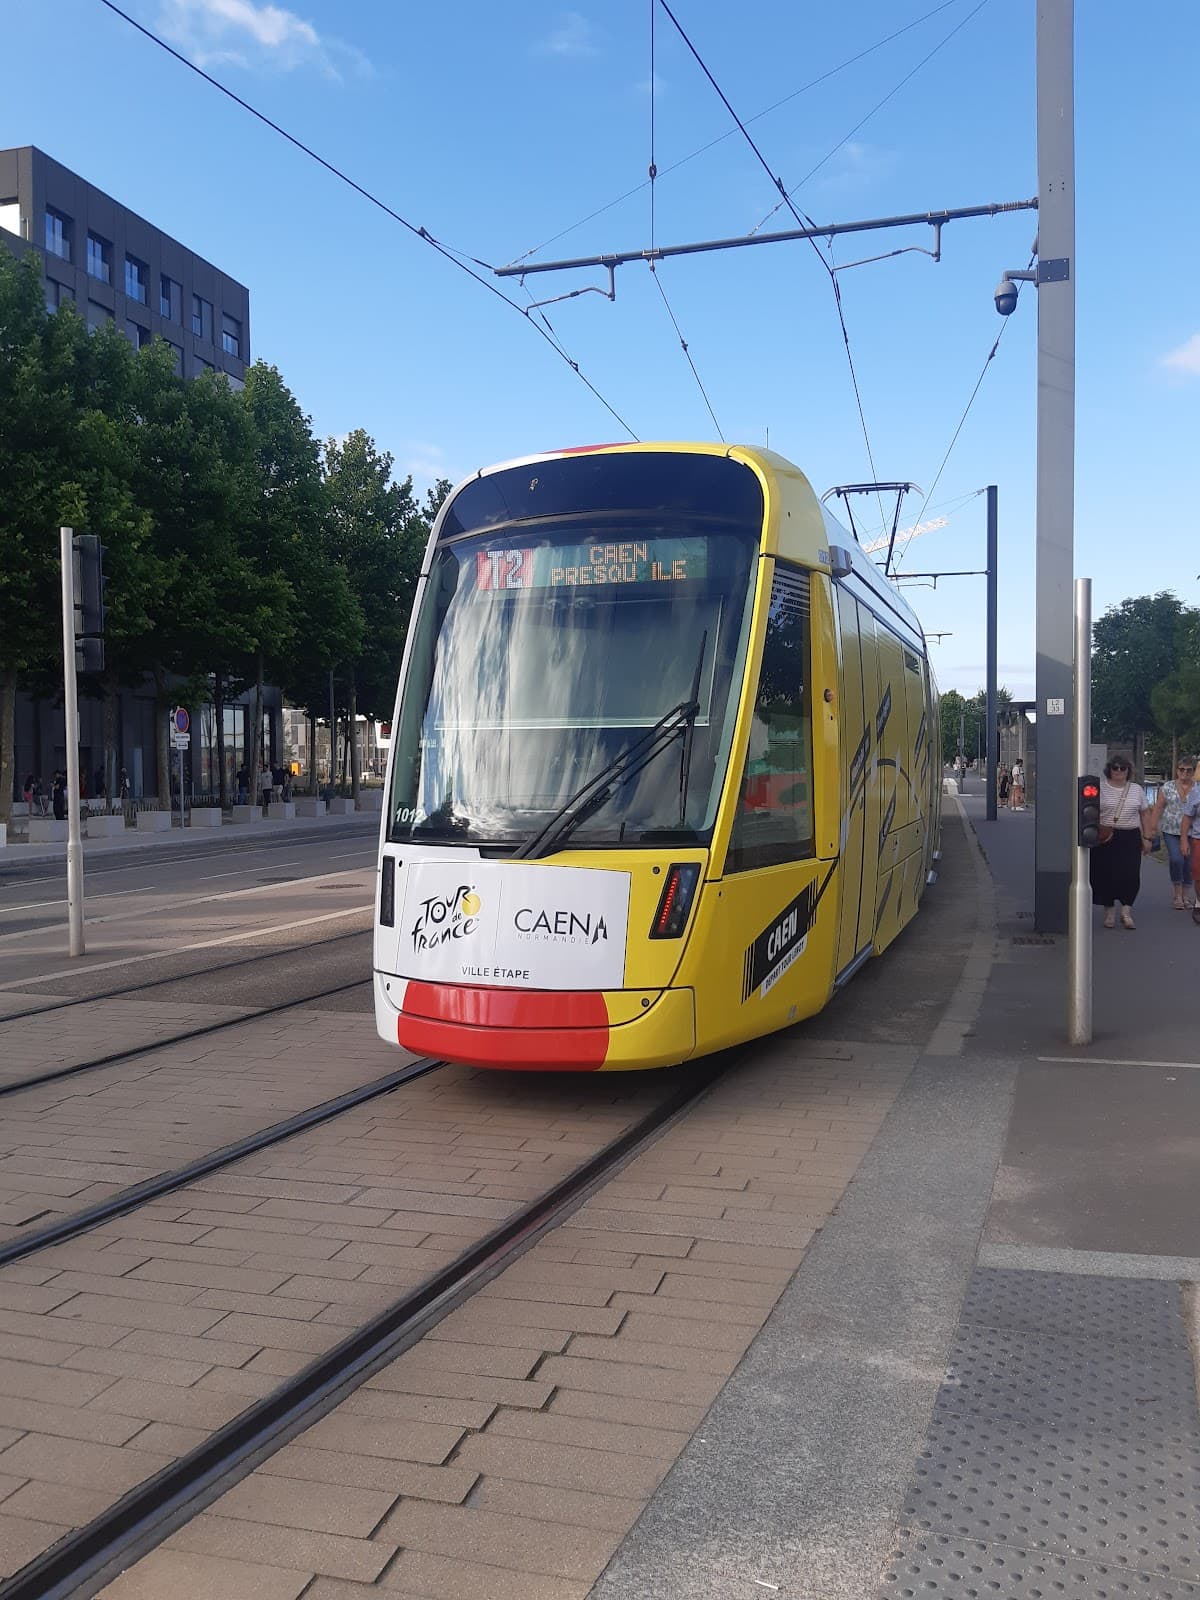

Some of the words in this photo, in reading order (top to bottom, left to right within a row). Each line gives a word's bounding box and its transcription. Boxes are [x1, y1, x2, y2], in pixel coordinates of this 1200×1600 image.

[588, 543, 648, 565] CAEN
[487, 549, 523, 589] T2
[551, 564, 637, 587] PRESQU
[650, 560, 687, 581] ILE
[396, 807, 423, 824] 1012
[451, 912, 463, 922] de
[517, 932, 590, 945] NORMANDIE
[767, 907, 798, 961] CAEN
[461, 966, 490, 977] VILLE
[493, 965, 530, 980] ÉTAPE
